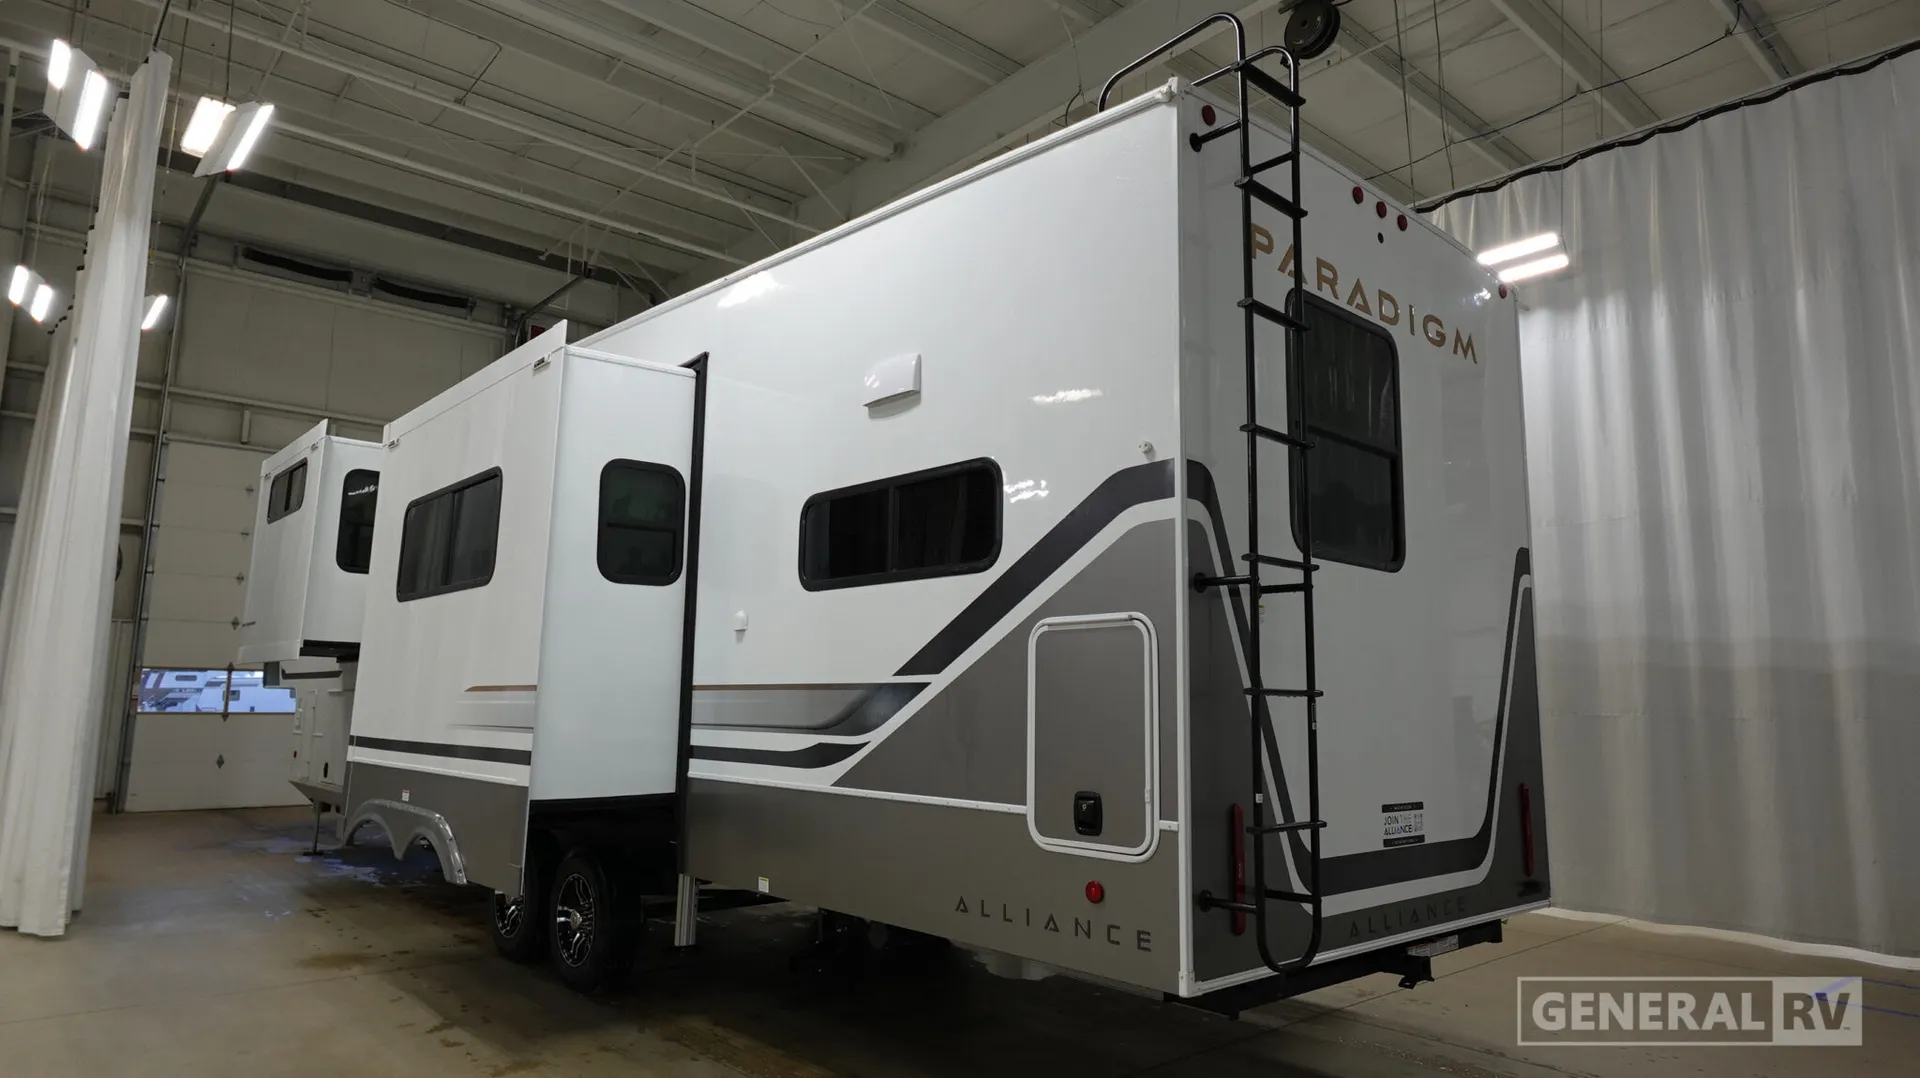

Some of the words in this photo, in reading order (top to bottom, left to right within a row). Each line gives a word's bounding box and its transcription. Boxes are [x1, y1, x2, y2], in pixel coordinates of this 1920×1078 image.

[1250, 222, 1478, 365] PARADIGM
[1384, 824, 1412, 835] ALLIANCE
[955, 896, 1152, 952] ALLIANCE
[1349, 896, 1466, 939] ALLIANCE
